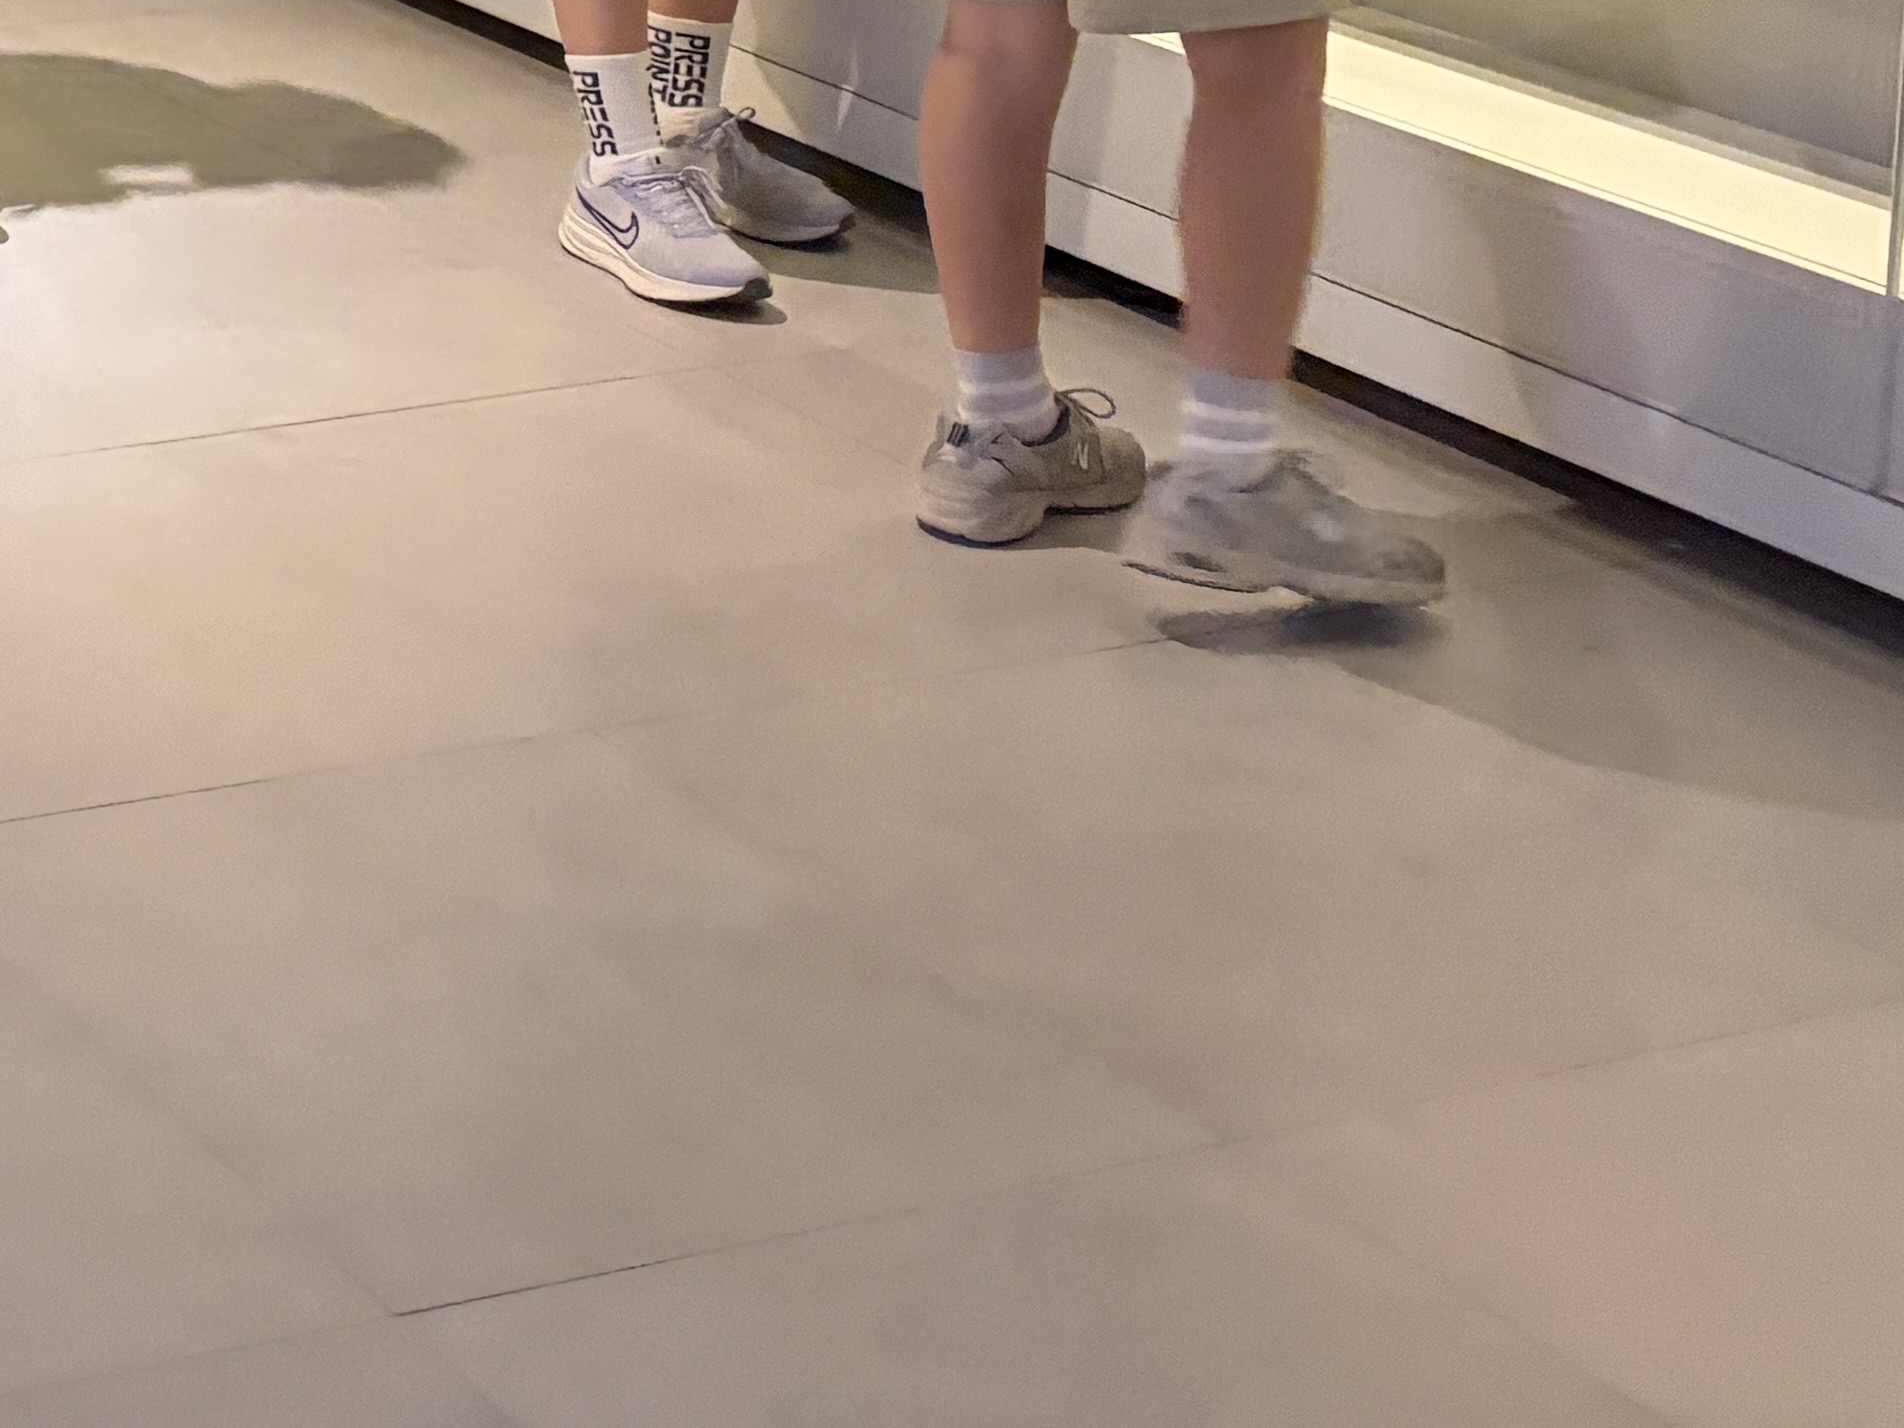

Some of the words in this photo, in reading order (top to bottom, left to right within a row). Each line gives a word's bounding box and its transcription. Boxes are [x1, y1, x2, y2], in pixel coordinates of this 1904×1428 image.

[646, 25, 673, 103] POINT
[667, 31, 711, 108] PRESS
[572, 70, 619, 157] PRESS
